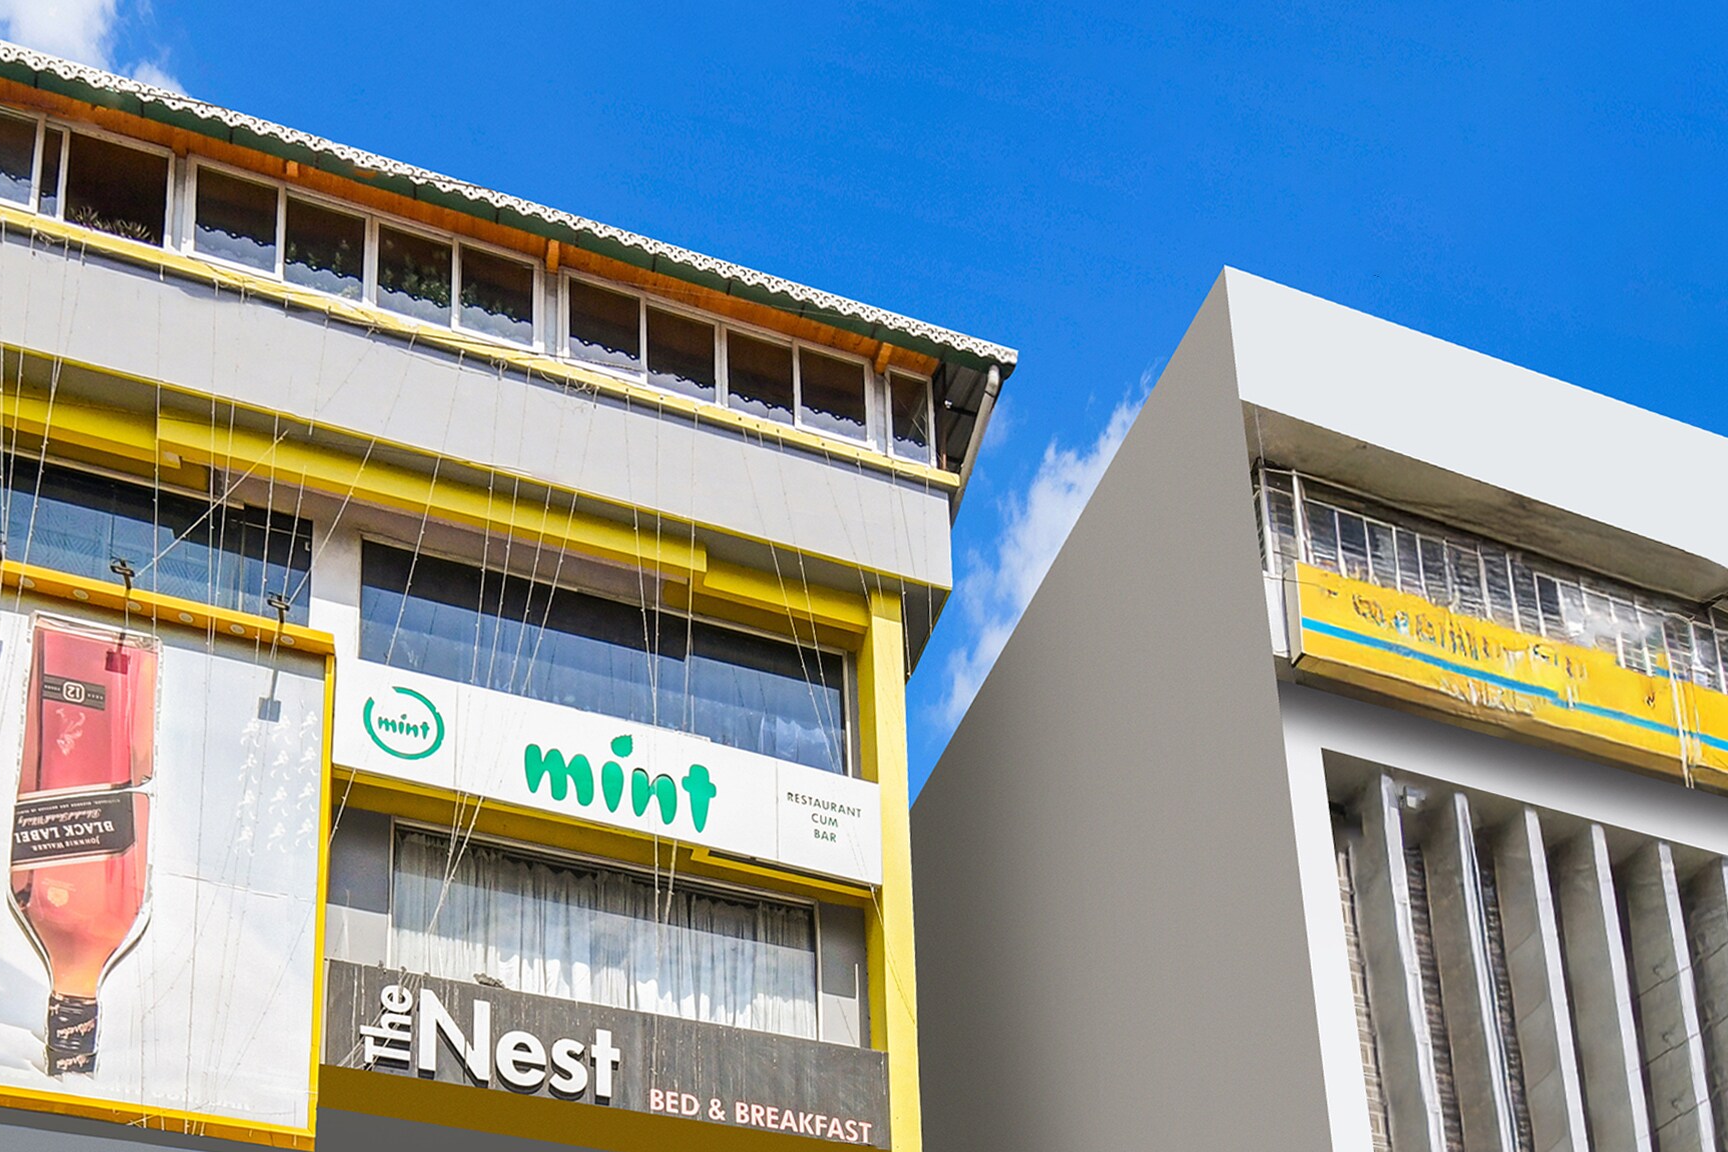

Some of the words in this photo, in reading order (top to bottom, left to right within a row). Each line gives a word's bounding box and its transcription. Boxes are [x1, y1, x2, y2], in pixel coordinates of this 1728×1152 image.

[67, 685, 81, 699] 12
[377, 713, 431, 741] mint
[524, 734, 716, 833] mint
[786, 791, 862, 818] RESTAURANT
[63, 820, 115, 837] BLACK
[811, 812, 839, 828] CUM
[813, 828, 838, 843] BAR
[360, 984, 413, 1063] The
[417, 987, 620, 1100] Nest
[649, 1087, 700, 1117] BED
[708, 1097, 727, 1122] &
[735, 1100, 873, 1144] BREAKFAST
